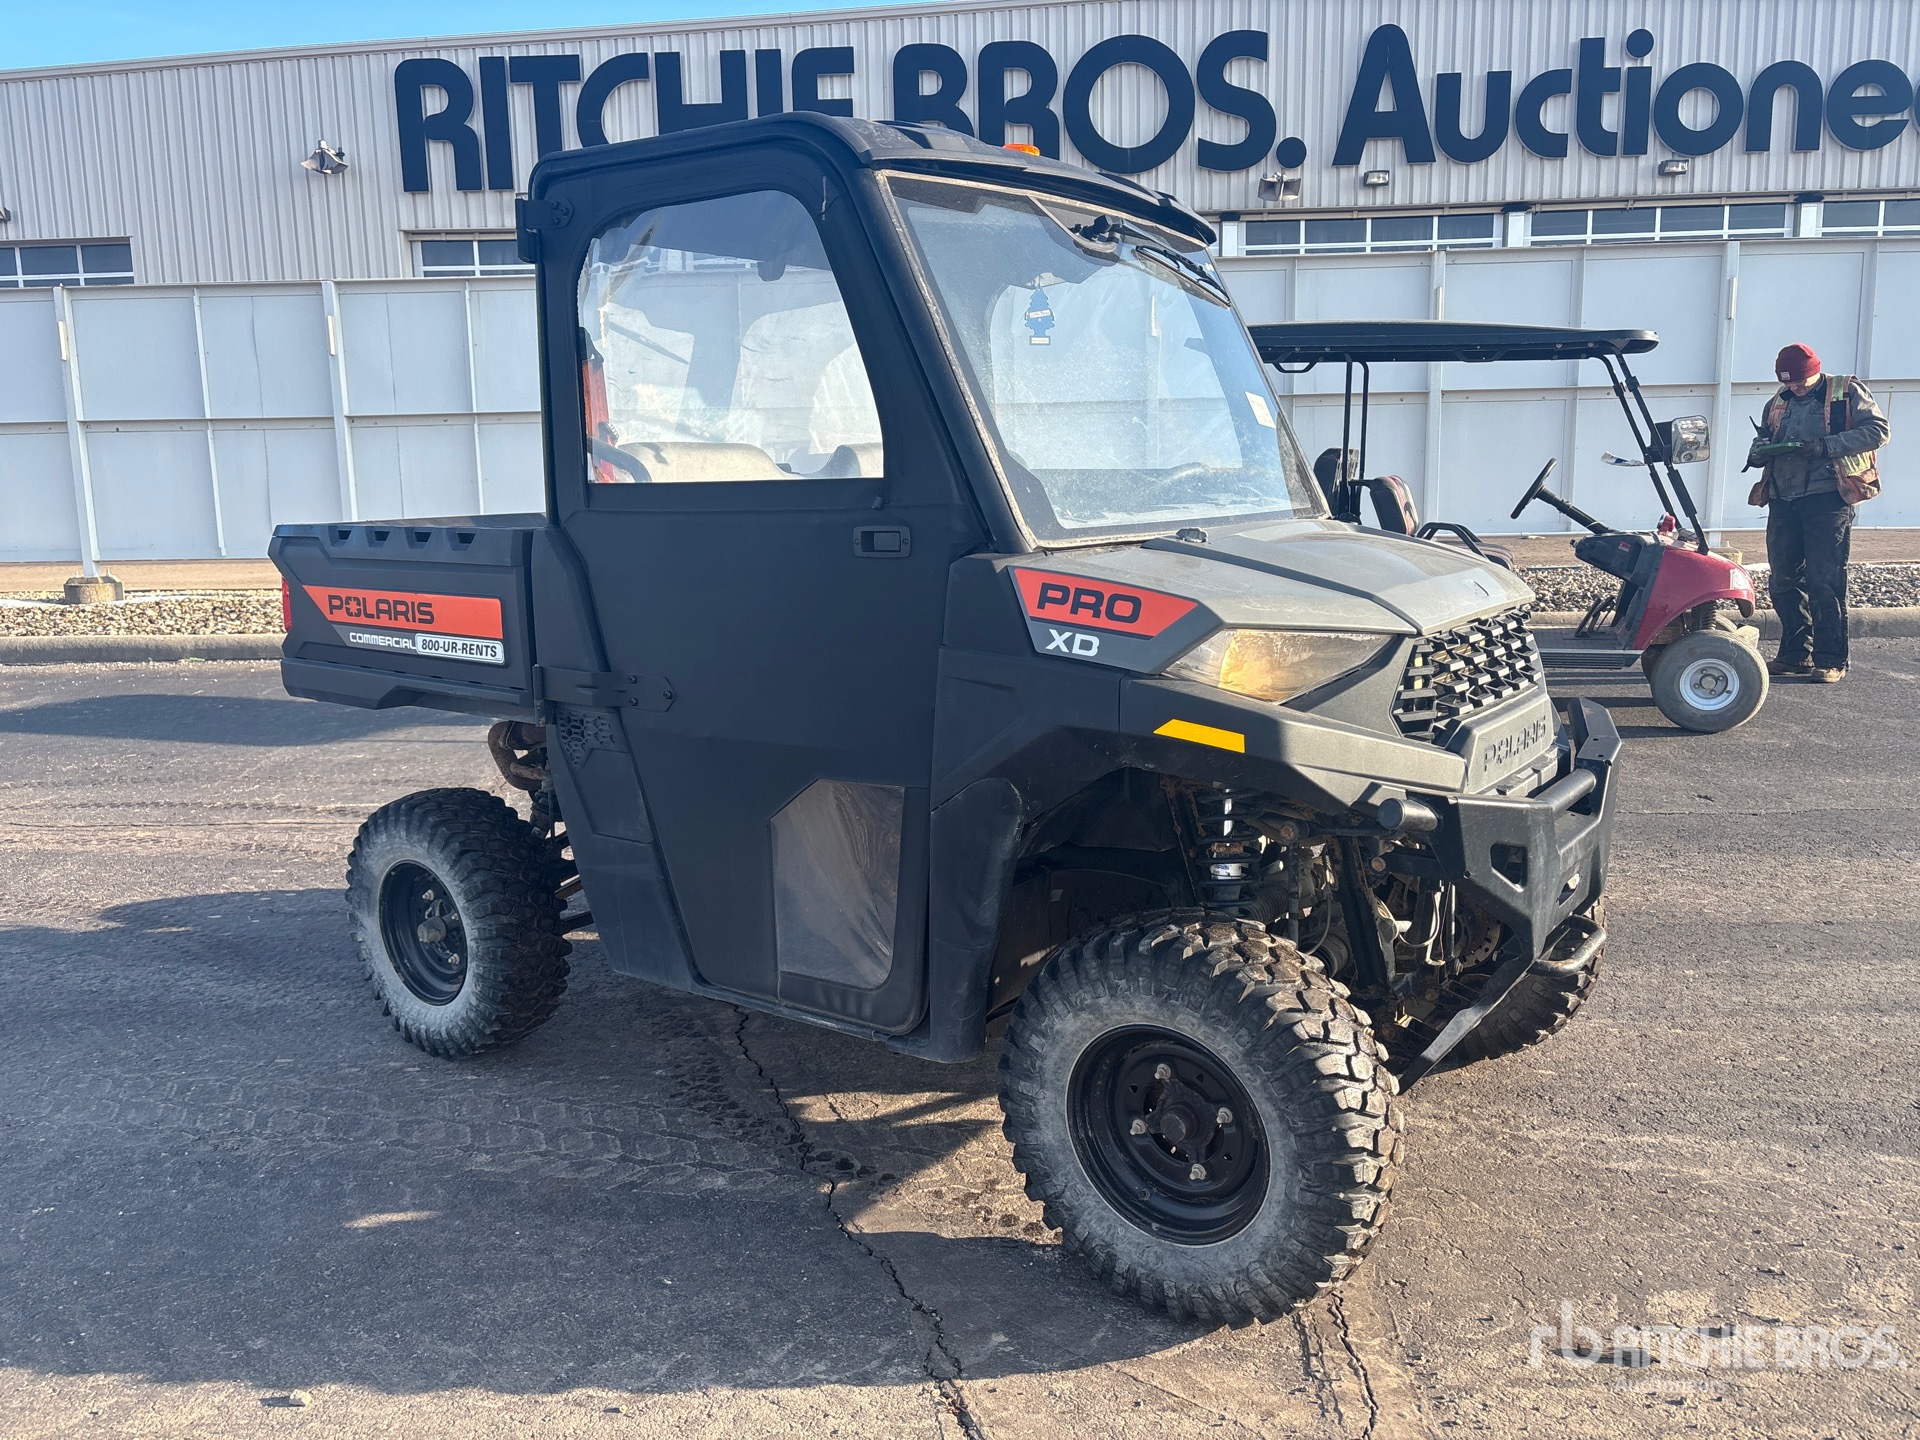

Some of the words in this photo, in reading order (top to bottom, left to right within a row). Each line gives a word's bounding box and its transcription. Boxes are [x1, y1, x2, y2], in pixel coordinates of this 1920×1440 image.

[394, 46, 855, 192] RITCHIE
[892, 30, 1307, 174] BROS.
[1332, 24, 1920, 166] Auctione
[327, 594, 435, 625] POLARIS
[1037, 582, 1142, 624] PRO
[349, 631, 416, 650] COMMERCIAL
[421, 638, 497, 658] 800-UR-RENTS
[1045, 628, 1100, 657] XD
[1484, 715, 1546, 772] POLARIS
